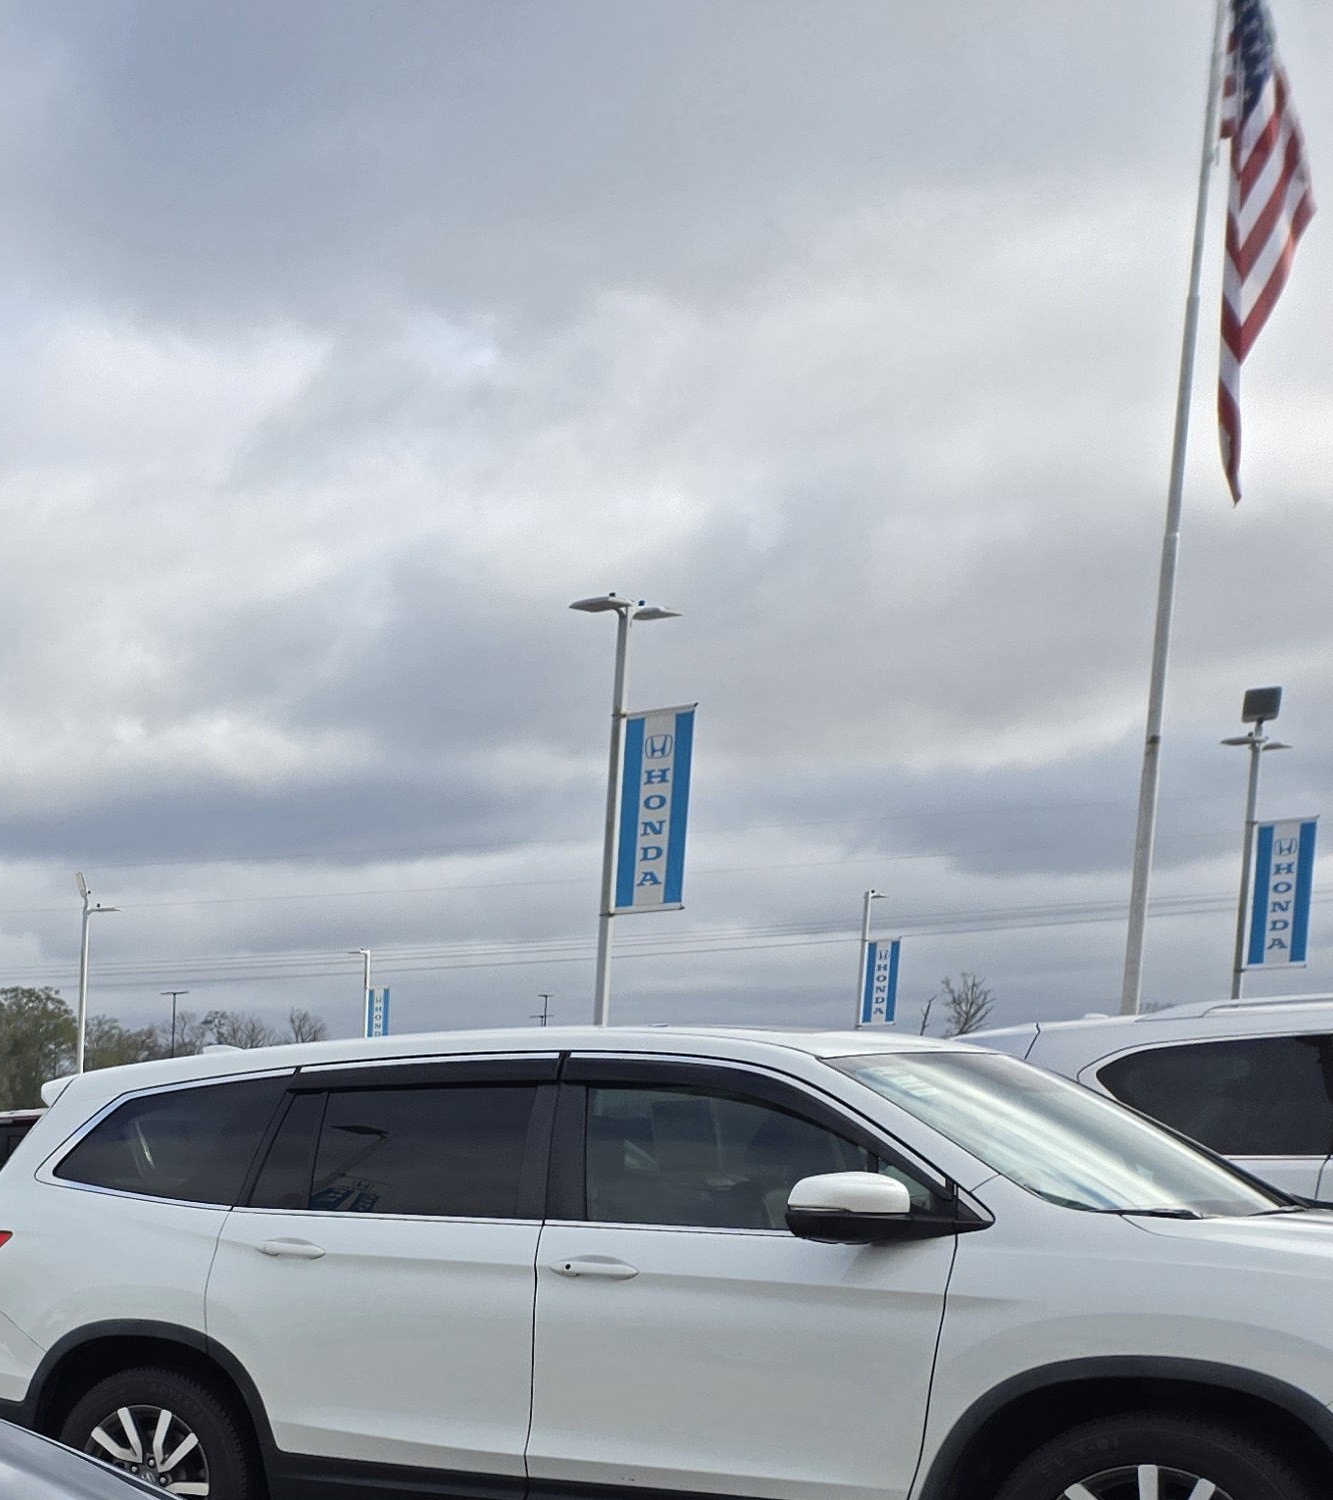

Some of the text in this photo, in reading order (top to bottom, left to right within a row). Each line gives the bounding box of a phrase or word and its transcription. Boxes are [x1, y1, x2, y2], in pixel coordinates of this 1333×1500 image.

[636, 767, 671, 887] HONDA
[1266, 862, 1294, 950] HONDA
[374, 1006, 383, 1038] HOND
[873, 963, 888, 1015] HONDA
